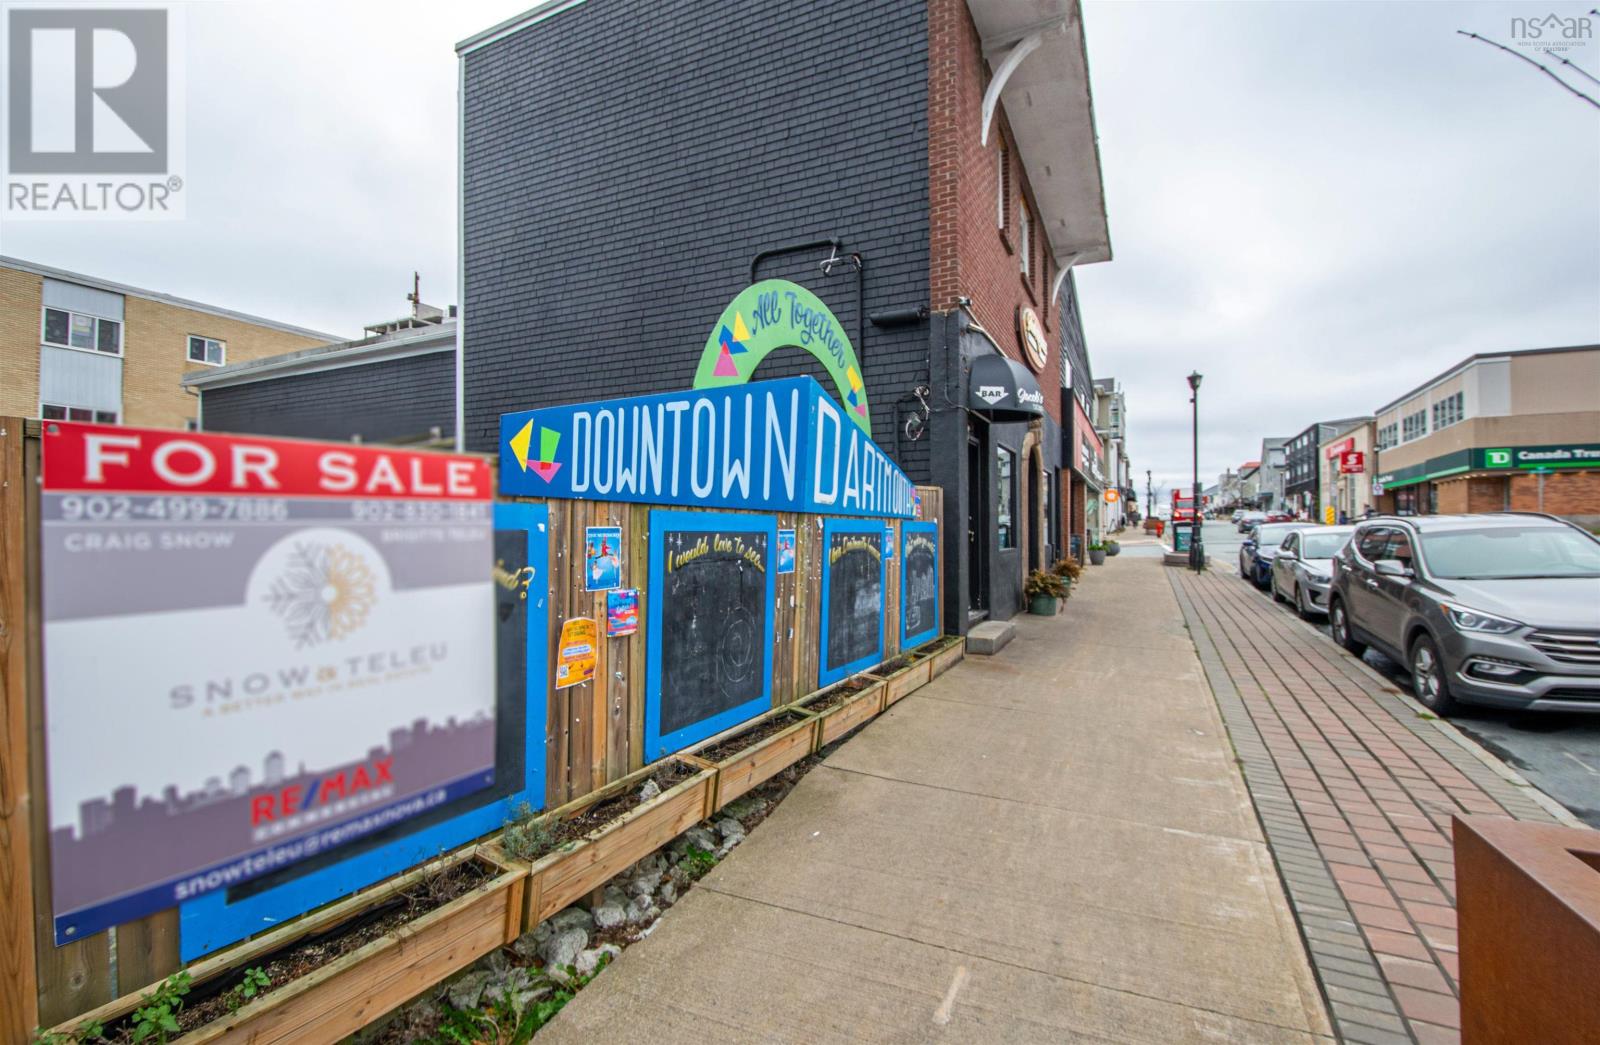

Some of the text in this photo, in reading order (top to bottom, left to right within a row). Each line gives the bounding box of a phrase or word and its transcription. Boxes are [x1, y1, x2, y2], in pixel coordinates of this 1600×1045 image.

[752, 290, 846, 369] All Together
[981, 390, 1002, 398] BAR
[83, 432, 477, 496] FOR SALE
[571, 388, 799, 501] DOWNTOWN
[814, 396, 913, 516] DARTMOUTH
[1488, 452, 1509, 464] TD
[1518, 449, 1571, 460] Canada
[63, 530, 236, 552] CRAIG SNOW
[675, 535, 709, 569] would
[713, 533, 733, 553] love
[168, 666, 310, 710] SNOW
[346, 641, 449, 676] TELEU
[251, 756, 396, 828] RE/MAX
